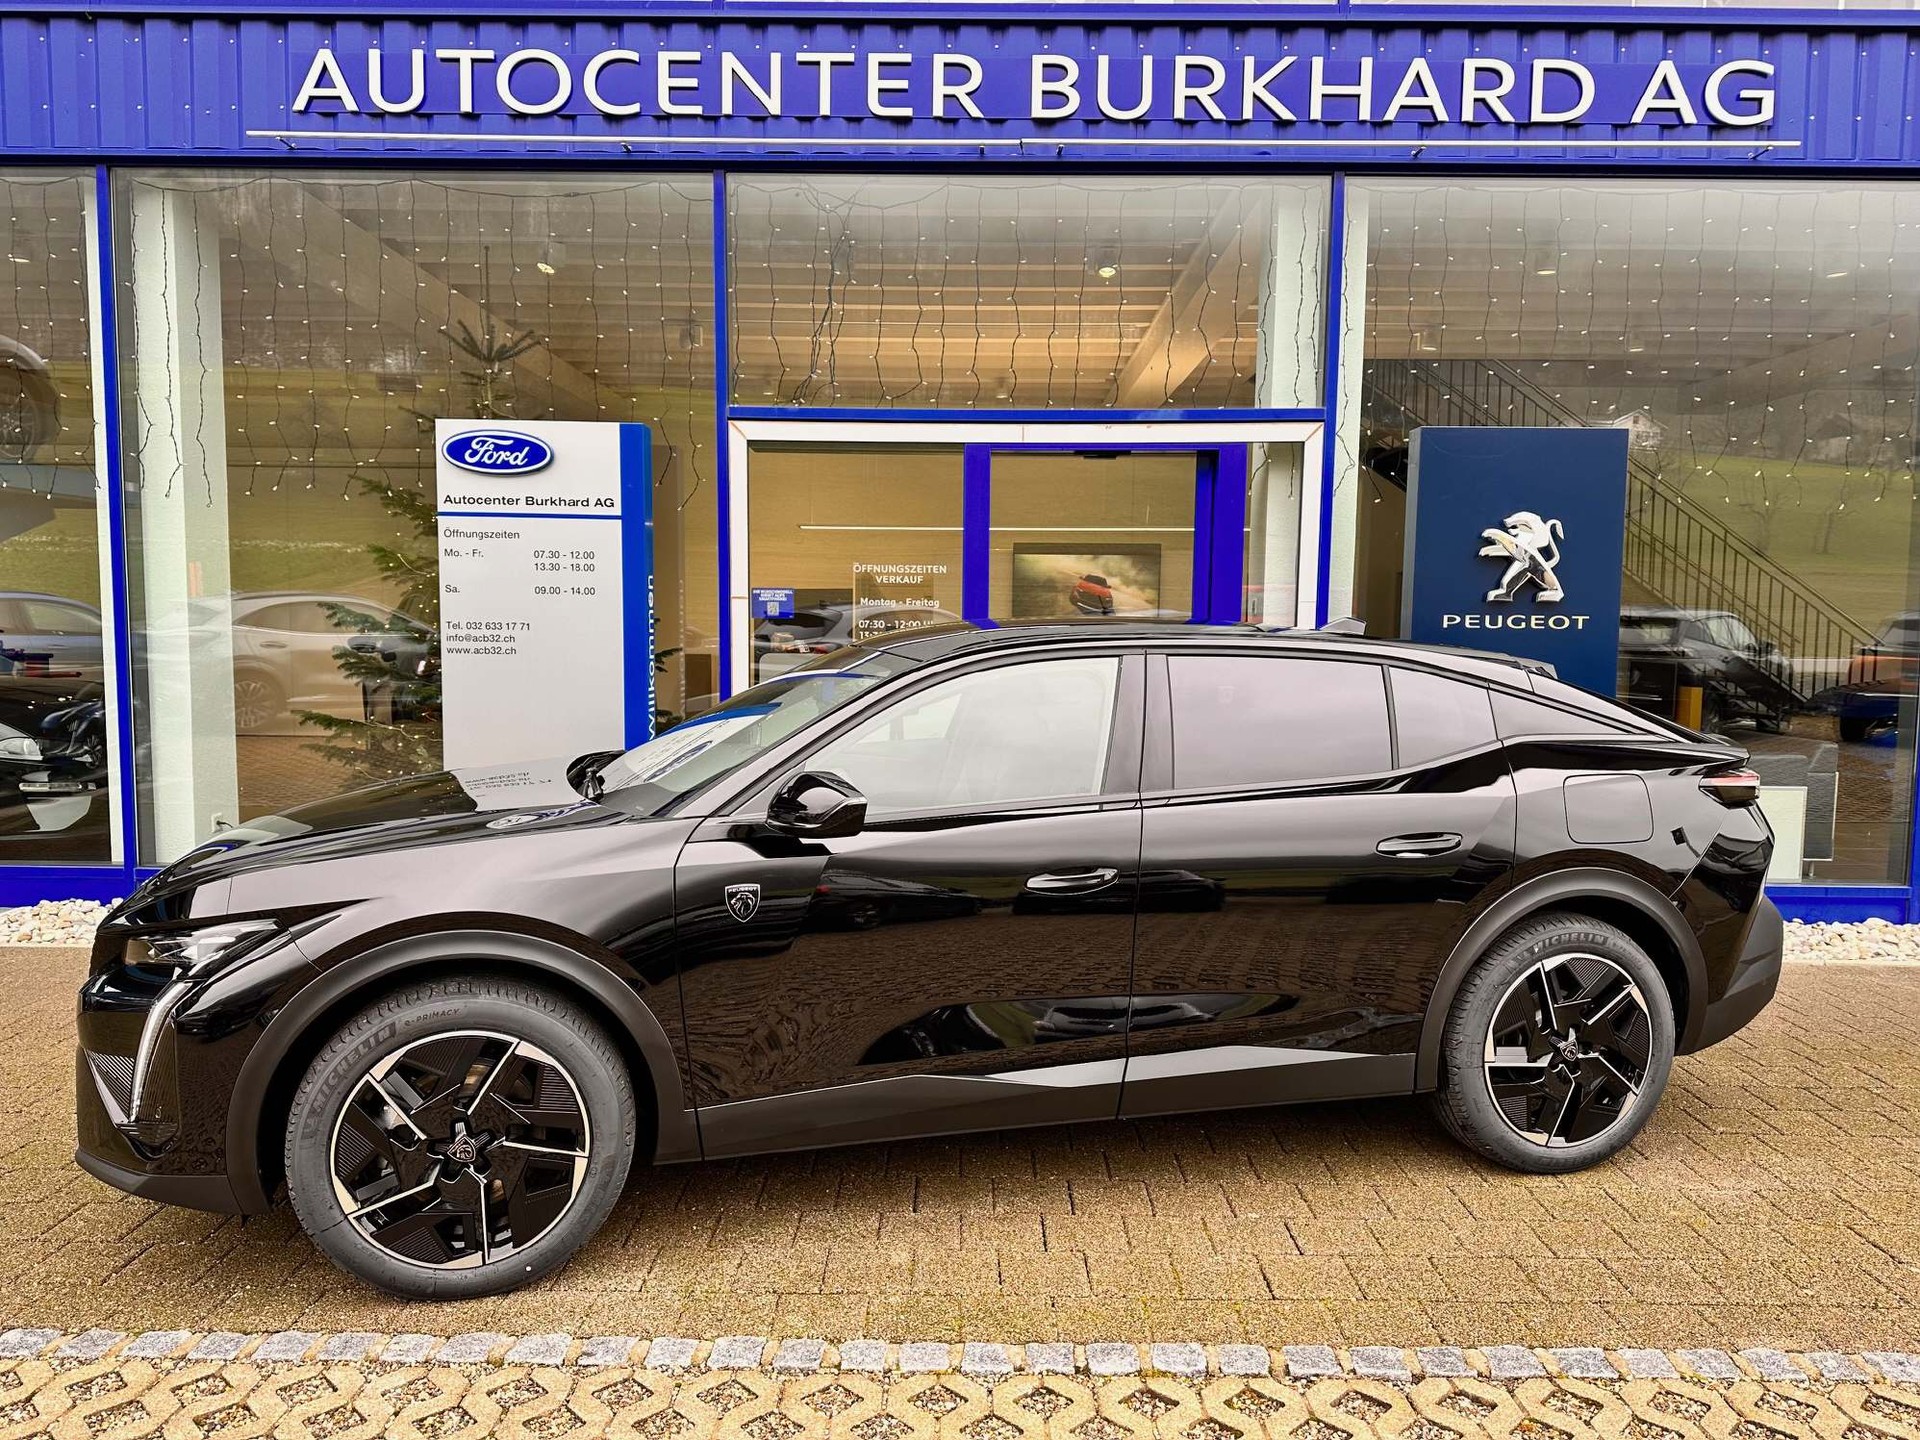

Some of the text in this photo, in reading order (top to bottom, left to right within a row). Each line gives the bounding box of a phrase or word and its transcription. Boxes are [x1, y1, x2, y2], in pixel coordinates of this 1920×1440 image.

[291, 48, 1777, 127] AUTOCENTER BURKHARD AG
[464, 436, 530, 466] Ford
[443, 494, 615, 508] Autocenter Burkhard AG
[443, 527, 520, 541] Öffnungszeiten
[444, 549, 463, 558] Mo.
[472, 549, 485, 558] Fr.
[533, 550, 560, 559] 07.30
[570, 550, 595, 560] 12.00
[534, 562, 561, 572] 13.30
[570, 563, 595, 572] 18.00
[853, 562, 947, 574] ÖFFNUNGSZEITEN
[876, 575, 924, 584] VERKAUF
[444, 585, 461, 593] Sa.
[534, 586, 560, 595] 09.00
[570, 587, 596, 596] 14.00
[860, 597, 896, 608] Montag
[906, 598, 940, 609] Freitag
[446, 620, 531, 631] Tel. 032 633 17 71
[858, 620, 885, 629] 07:30
[1442, 614, 1590, 630] PEUGEOT
[446, 633, 516, 643] info@acb32.ch
[446, 646, 517, 655] www.acb32.ch
[1533, 931, 1605, 953] MICHELIN
[311, 1026, 393, 1114] MICHELIN
